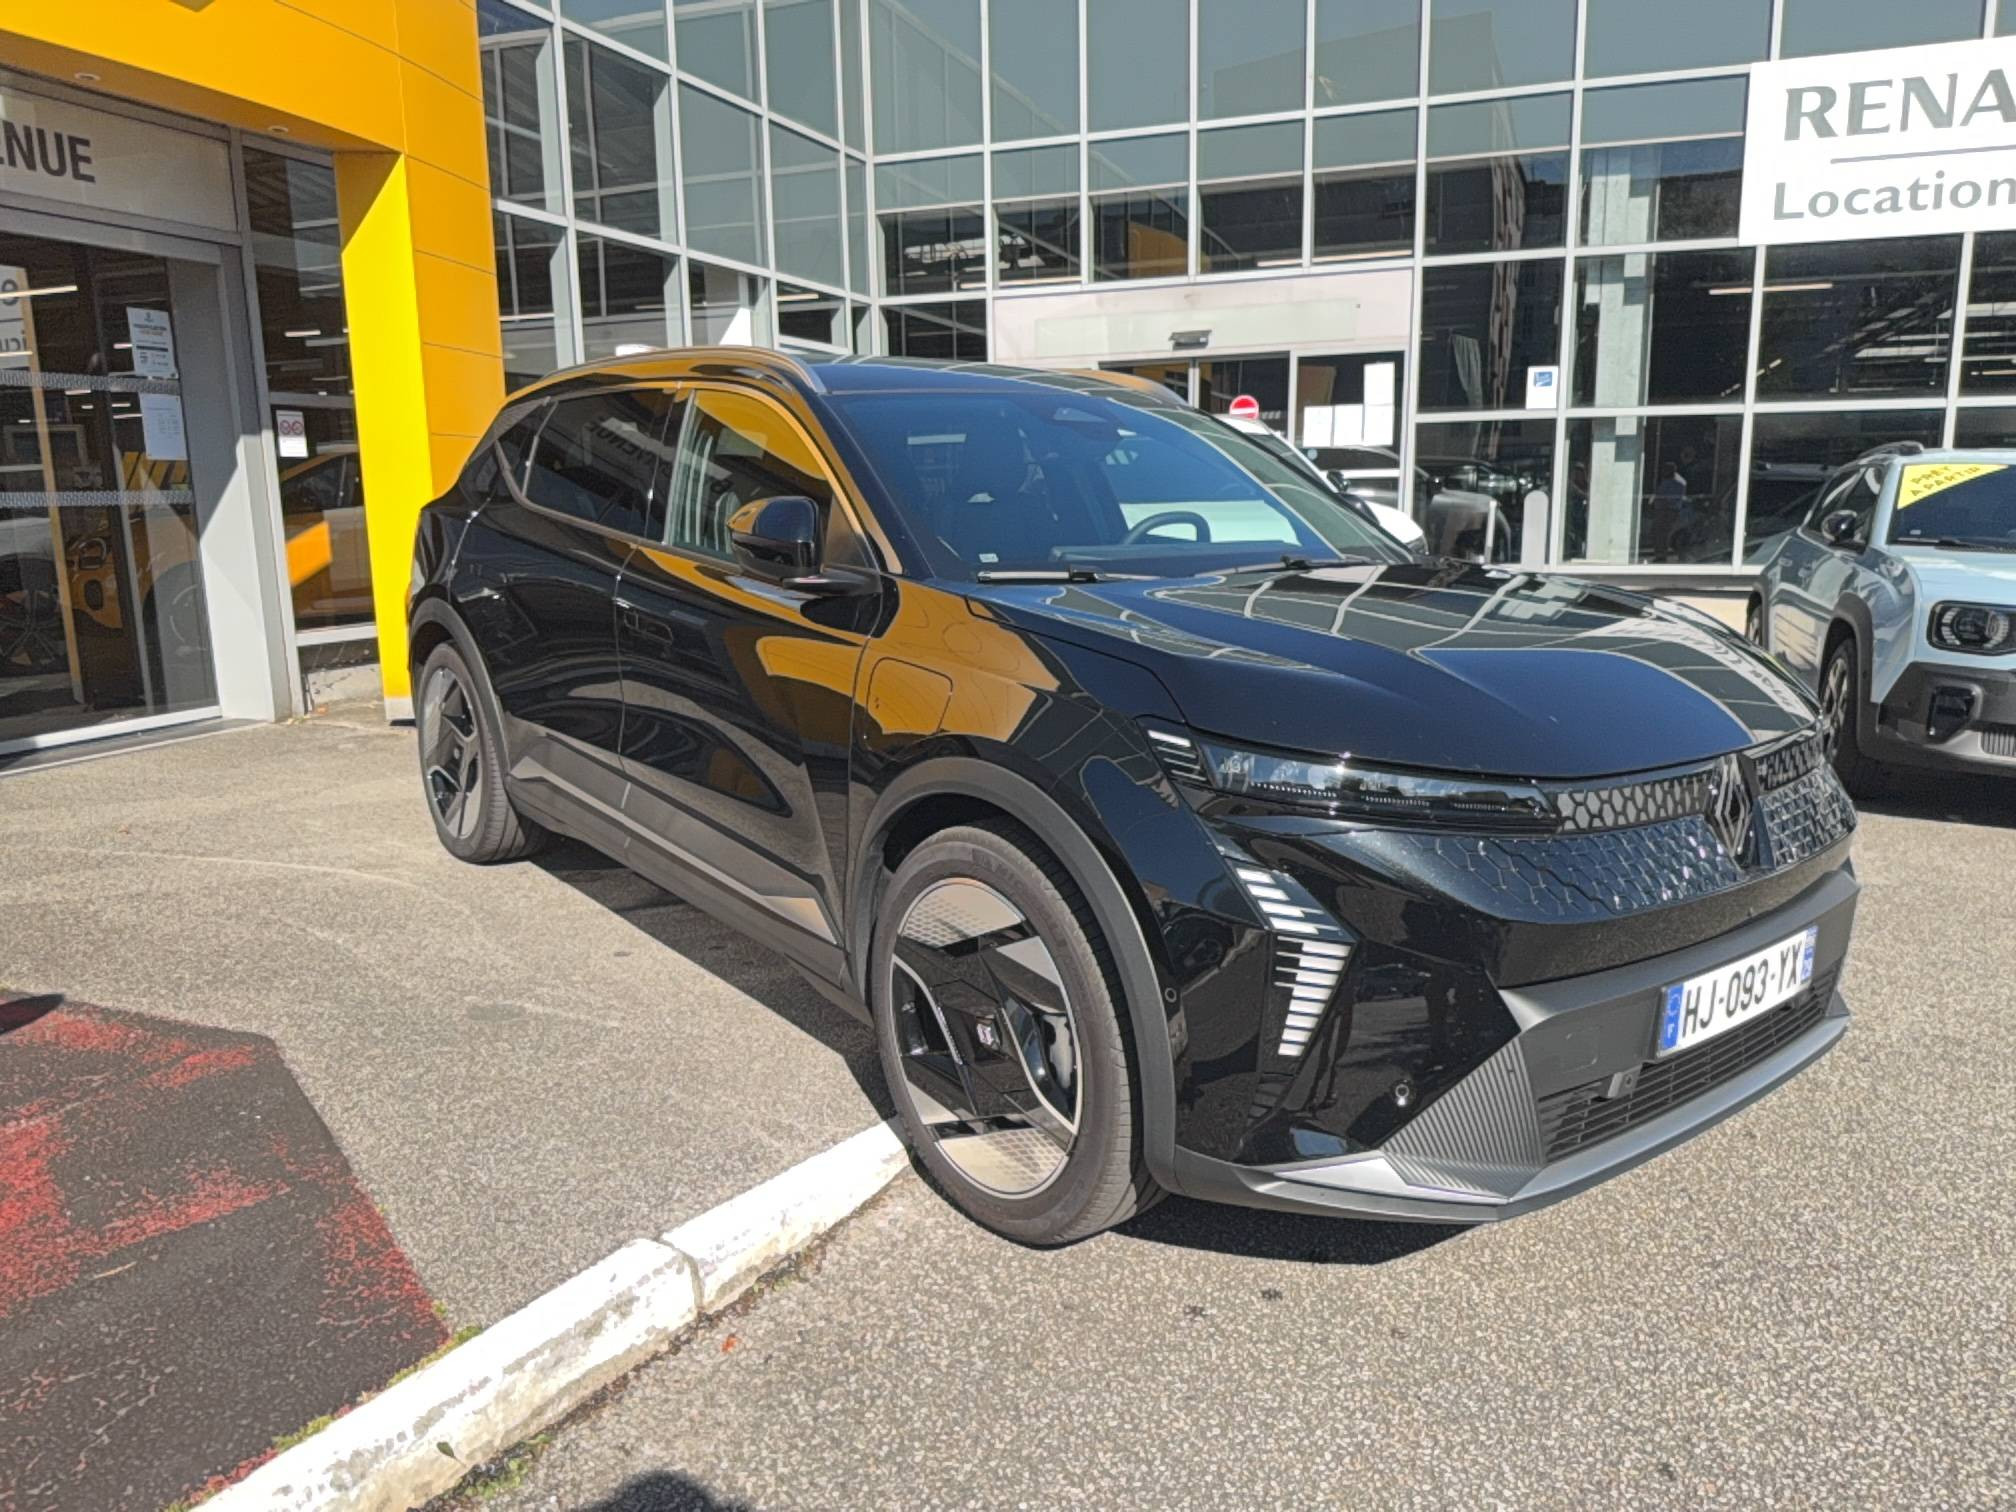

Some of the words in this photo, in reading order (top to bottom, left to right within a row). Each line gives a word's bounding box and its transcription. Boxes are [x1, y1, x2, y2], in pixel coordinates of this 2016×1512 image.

[1784, 68, 2016, 141] RENA
[0, 119, 96, 183] NUE
[1773, 170, 2016, 220] Location
[1682, 941, 1802, 1038] HJ-093-YX
